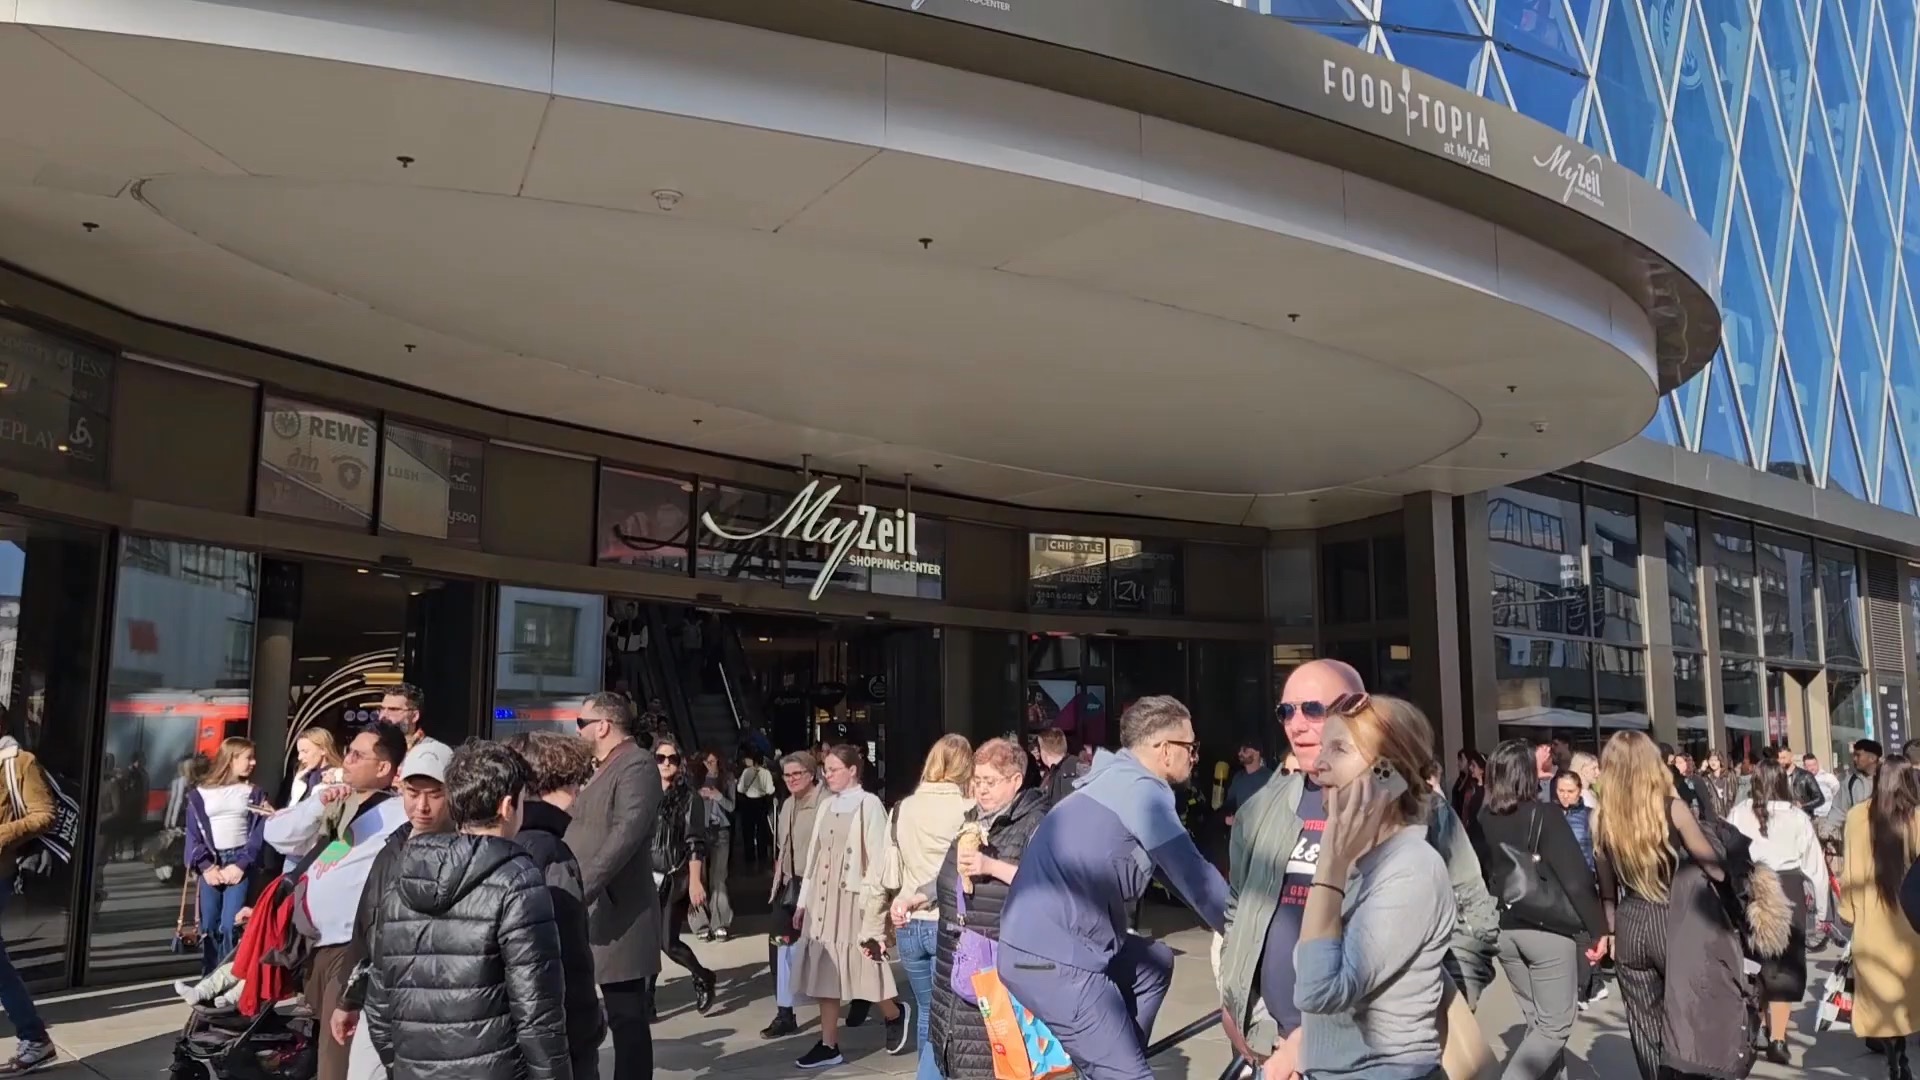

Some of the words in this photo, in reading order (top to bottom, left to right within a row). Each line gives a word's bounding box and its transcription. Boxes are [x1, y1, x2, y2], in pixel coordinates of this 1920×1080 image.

[1323, 59, 1393, 115] FOOD
[1418, 93, 1490, 151] TOPIA
[1443, 141, 1456, 155] at
[1456, 144, 1492, 169] MyZeil
[56, 350, 107, 379] GUESS
[309, 416, 369, 447] REWE
[287, 447, 320, 471] dm
[387, 465, 420, 481] LUSH
[448, 510, 477, 525] yson
[1049, 540, 1102, 553] CHIPOTLE
[849, 554, 942, 576] SHOPPING-CENTER
[58, 809, 77, 842] NIKE
